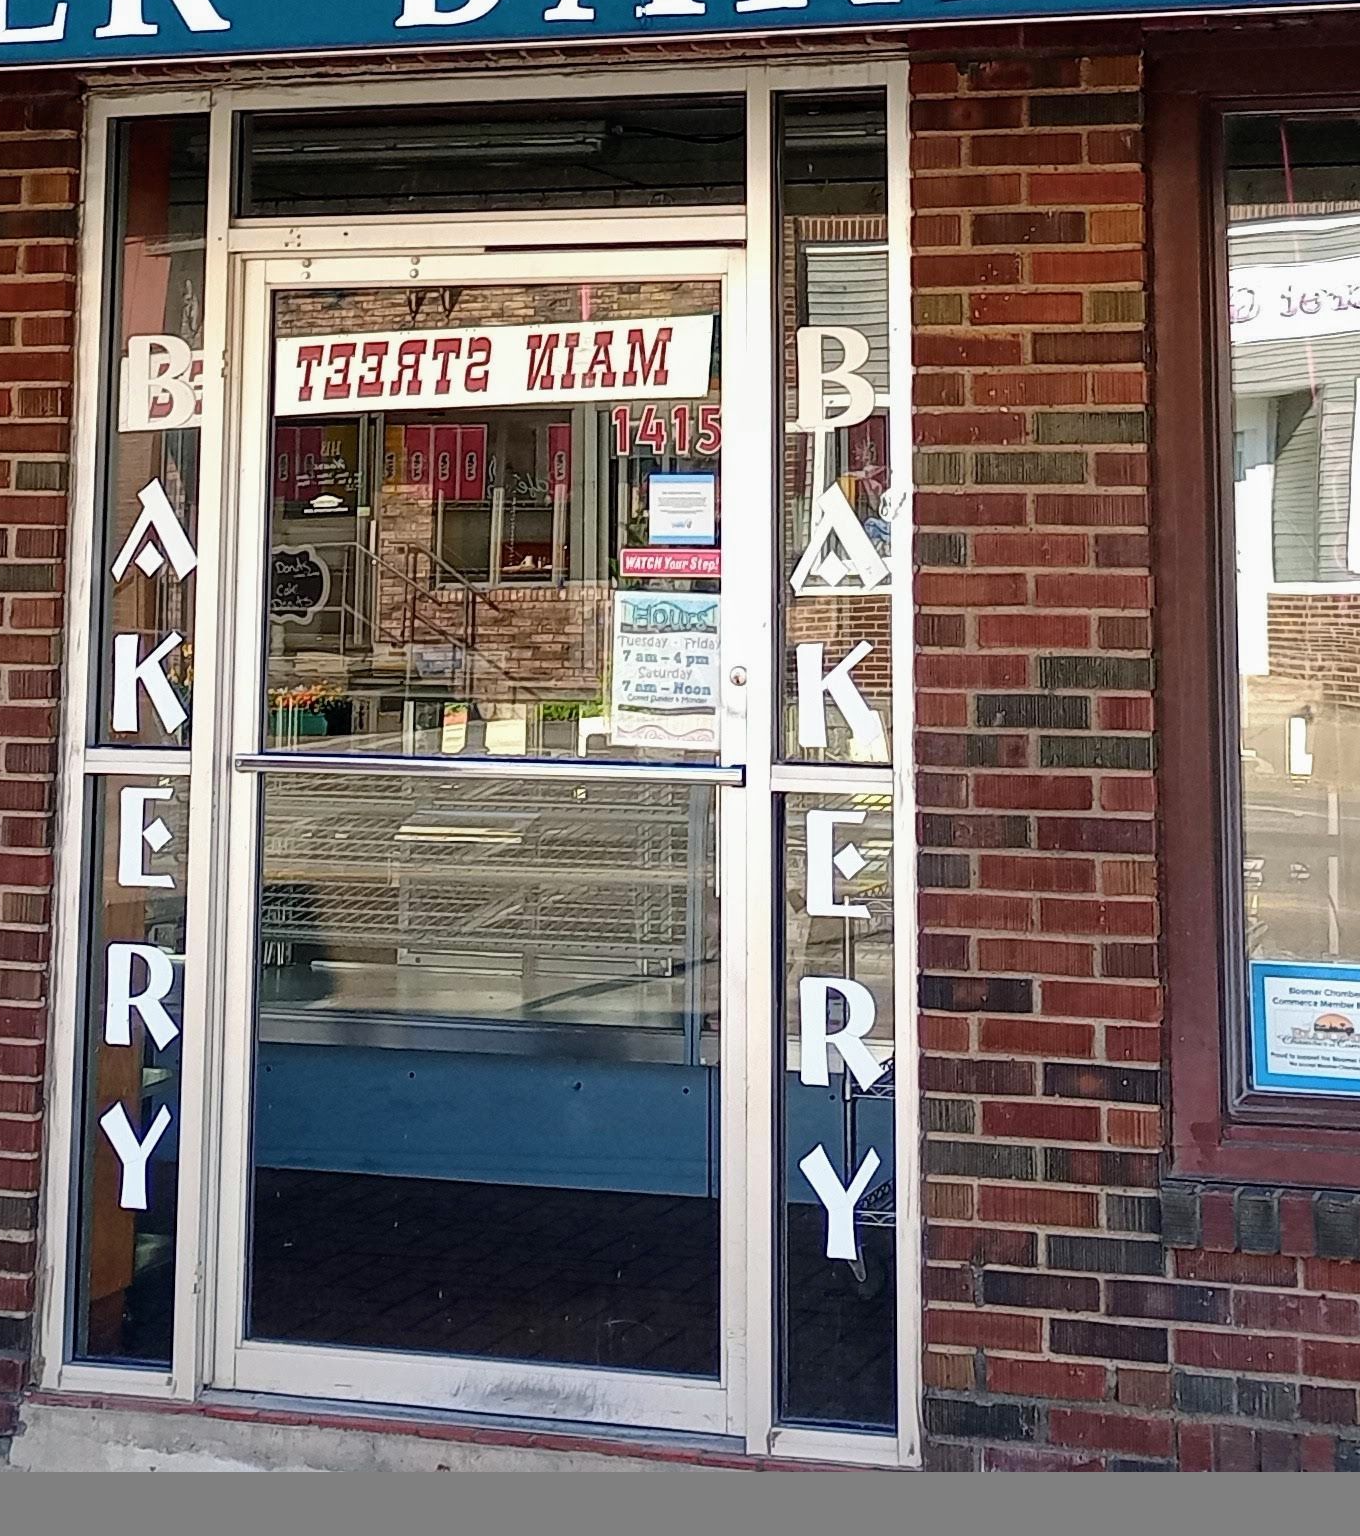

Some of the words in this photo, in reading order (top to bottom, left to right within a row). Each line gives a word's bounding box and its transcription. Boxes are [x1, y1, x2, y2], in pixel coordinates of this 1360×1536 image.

[612, 405, 721, 456] 1415
[625, 556, 662, 570] WATCH
[664, 556, 688, 570] Your
[690, 556, 720, 572] Step!
[632, 603, 709, 631] Hours
[617, 635, 668, 648] Tuesday
[685, 637, 721, 650] Friday
[623, 650, 631, 662] 7
[635, 653, 658, 663] am
[673, 652, 682, 663] 4
[686, 654, 709, 667] pm
[638, 666, 693, 680] Saturday
[622, 680, 631, 692] 7
[673, 681, 711, 696] Noon
[99, 333, 198, 1211] BAKERY
[789, 326, 890, 1260] BAKERY
[1289, 987, 1321, 996] Bloomer
[1272, 997, 1317, 1007] Commerce
[1320, 1000, 1354, 1009] Member
